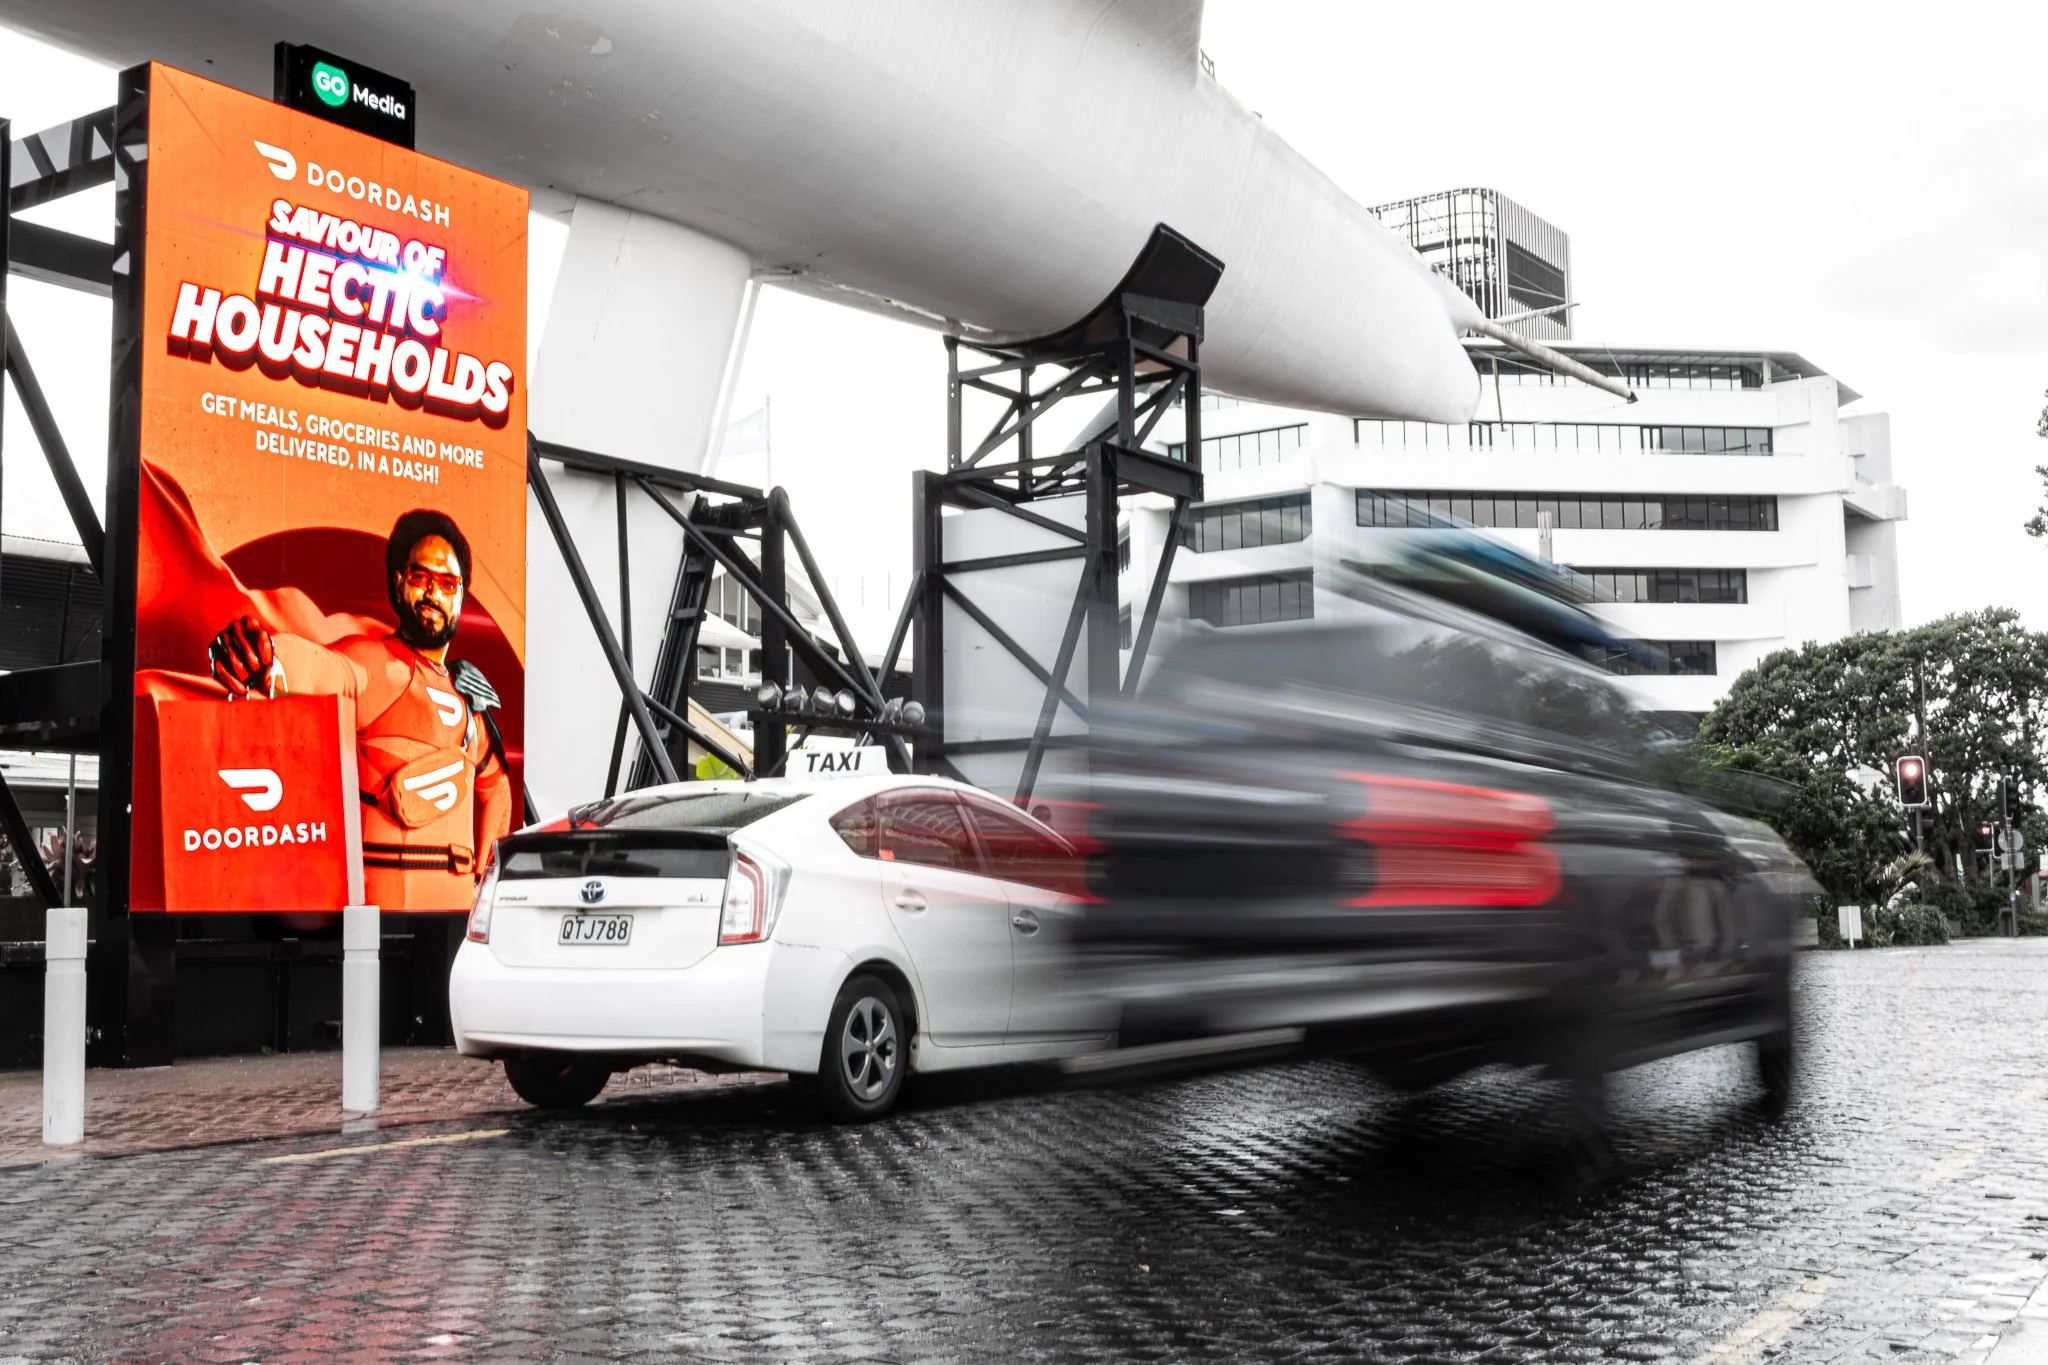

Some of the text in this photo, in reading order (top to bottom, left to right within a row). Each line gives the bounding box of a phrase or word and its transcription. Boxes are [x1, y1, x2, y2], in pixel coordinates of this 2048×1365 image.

[315, 71, 406, 120] GO Media
[307, 162, 450, 227] DOORDASH
[268, 200, 446, 277] SAVIOUR OF
[258, 241, 446, 336] HECTIC
[170, 281, 514, 414] HOUSEHOLDS
[201, 392, 484, 469] GET MEALS, GROCERIES AND MORE
[256, 429, 439, 485] DELIVERED, IN A DASH!
[806, 751, 862, 773] TAXI
[184, 821, 327, 852] DOORDASH
[562, 920, 629, 941] QTJ788
